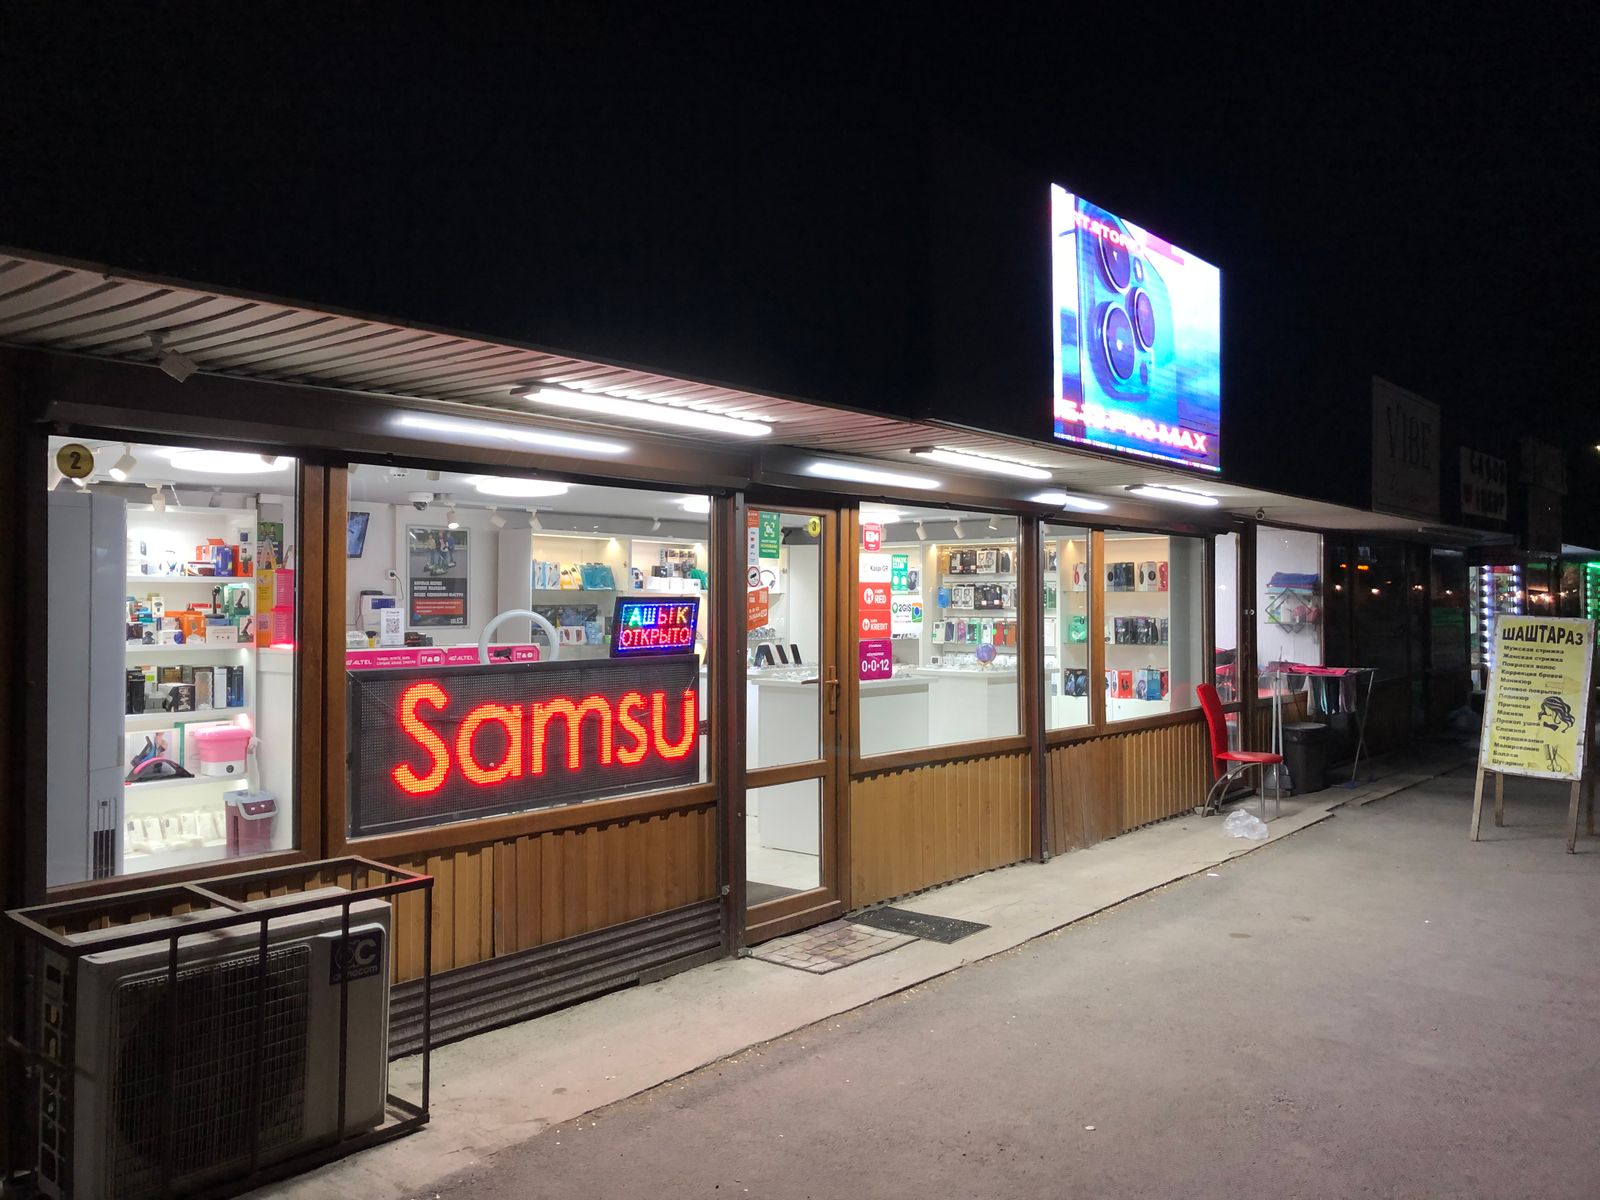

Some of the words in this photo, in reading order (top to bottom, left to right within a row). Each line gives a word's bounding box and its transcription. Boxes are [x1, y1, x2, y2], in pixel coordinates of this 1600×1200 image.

[1386, 402, 1432, 470] VIBE
[70, 451, 81, 469] 2
[811, 520, 817, 531] 3
[874, 594, 887, 604] RED
[898, 604, 912, 613] 2GIS
[870, 623, 888, 631] KREDIT
[621, 627, 690, 647] ОТКРЫТО
[1502, 625, 1584, 645] ШАШТАРАЗ
[1503, 645, 1534, 653] Мужская
[391, 681, 696, 795] Samsu
